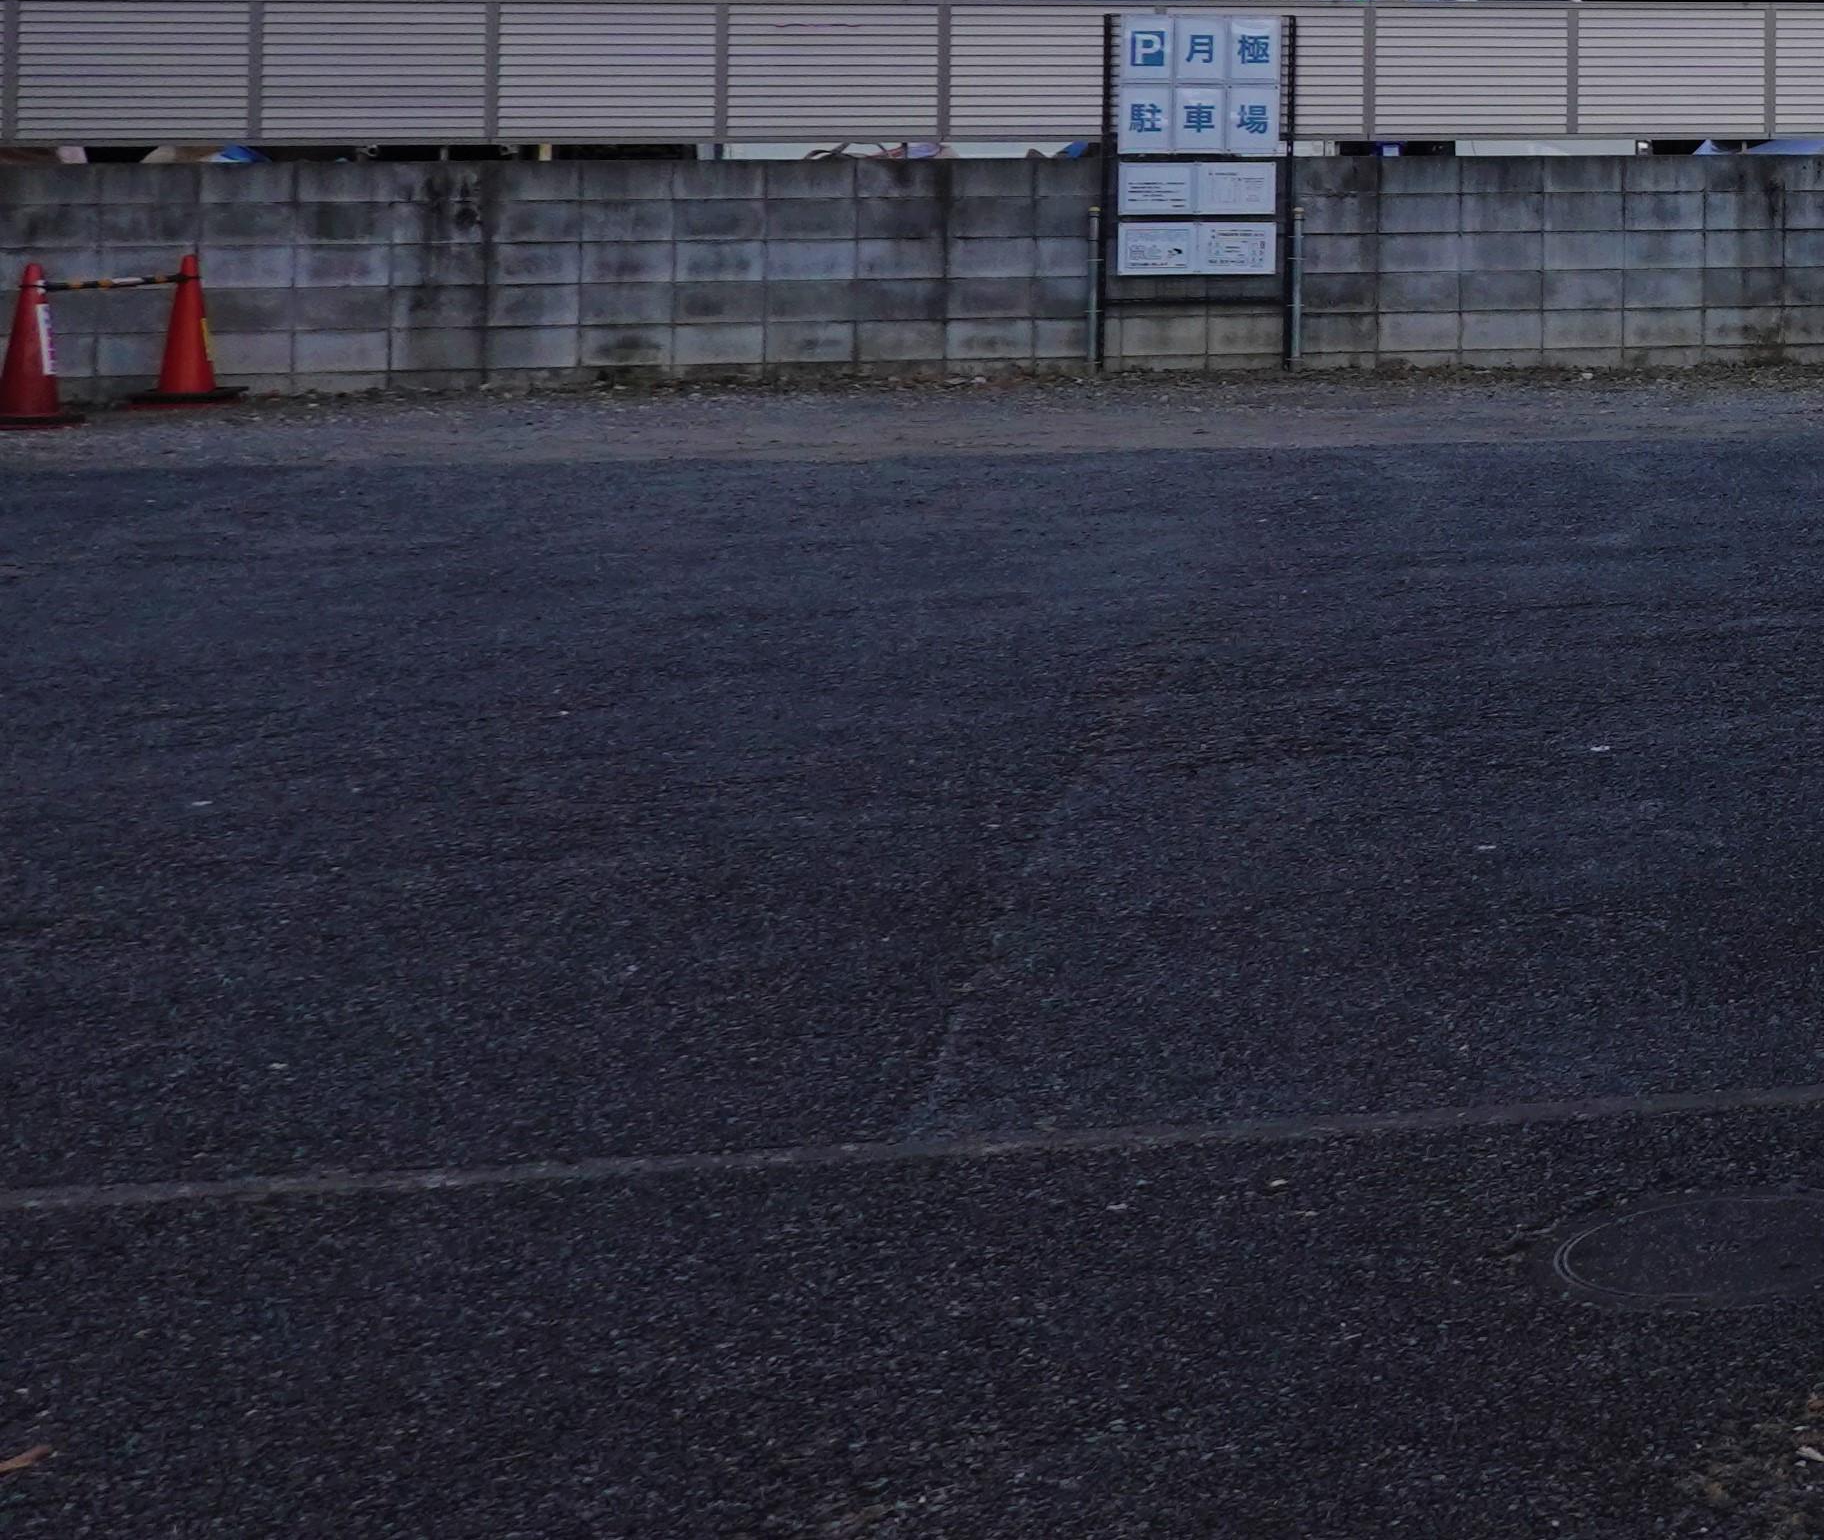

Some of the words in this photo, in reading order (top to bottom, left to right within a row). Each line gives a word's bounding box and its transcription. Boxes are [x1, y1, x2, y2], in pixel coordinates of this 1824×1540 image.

[1185, 33, 1270, 64] 月極
[1128, 102, 1270, 134] 駐車場
